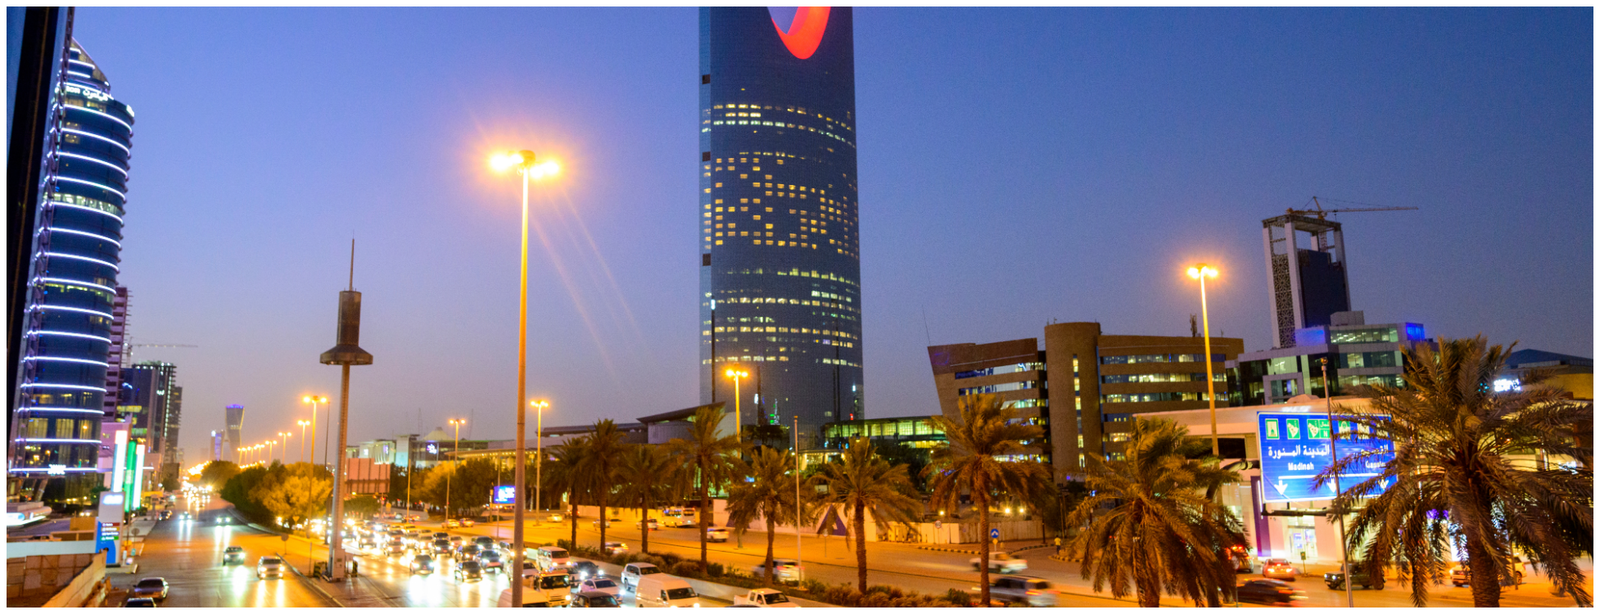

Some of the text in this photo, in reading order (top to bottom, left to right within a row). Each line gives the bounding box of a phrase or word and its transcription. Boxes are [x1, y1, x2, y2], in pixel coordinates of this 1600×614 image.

[1268, 444, 1330, 459] المدينة المنورة
[1288, 462, 1314, 471] Madinah
